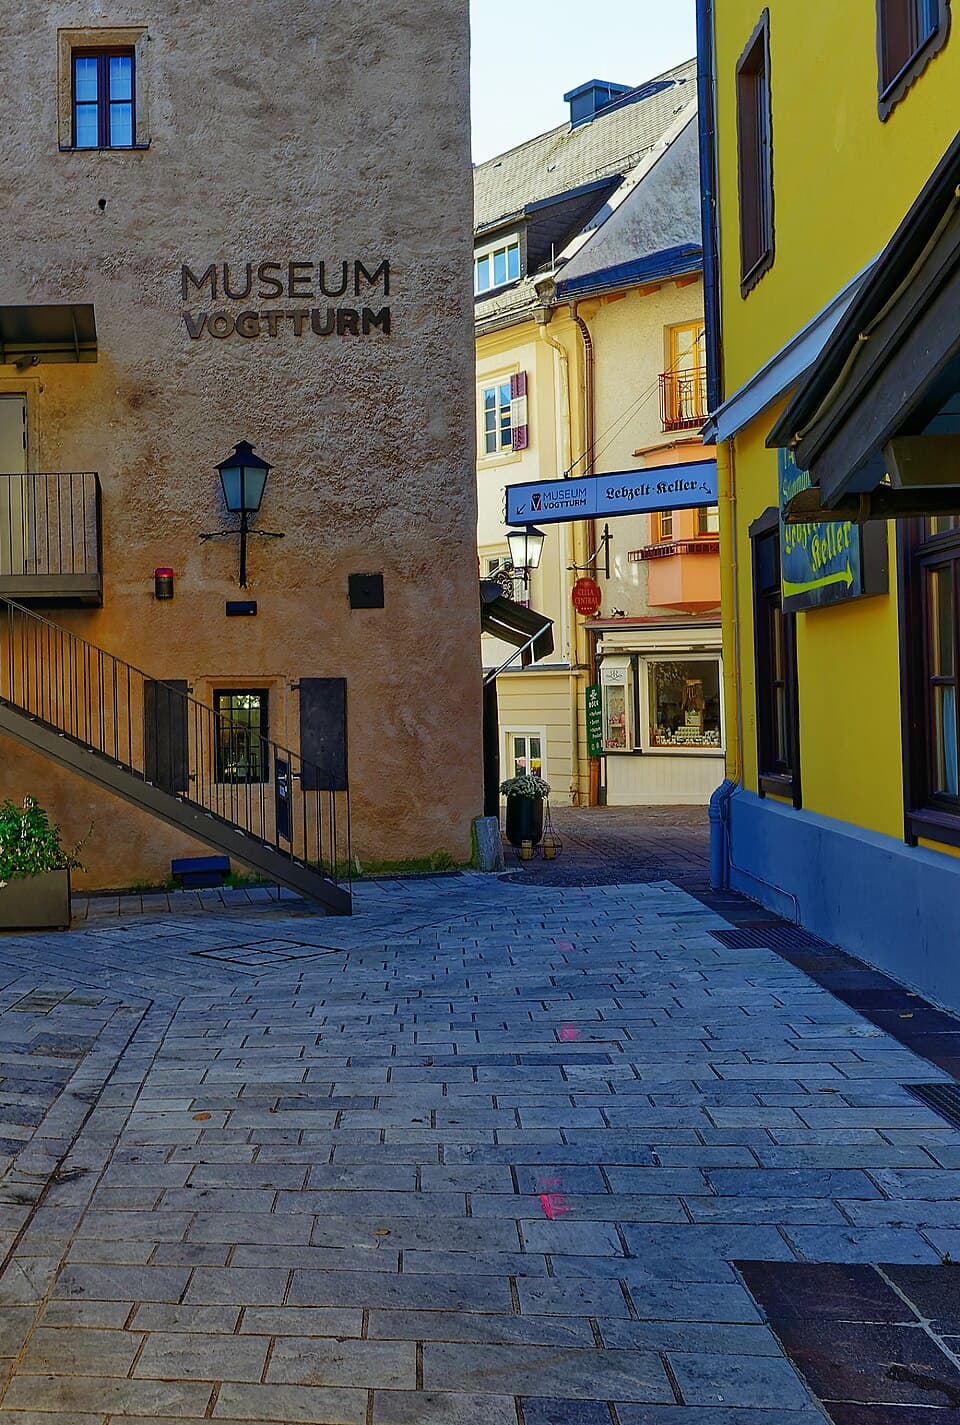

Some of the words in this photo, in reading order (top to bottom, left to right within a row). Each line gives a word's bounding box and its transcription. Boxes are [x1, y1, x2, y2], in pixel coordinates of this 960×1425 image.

[181, 259, 390, 300] MUSEUM
[183, 306, 390, 339] VOGTTURM
[543, 487, 587, 501] MUSEUM
[656, 478, 698, 495] Keller
[543, 498, 587, 510] VOGTTURM
[811, 521, 851, 573] Keller
